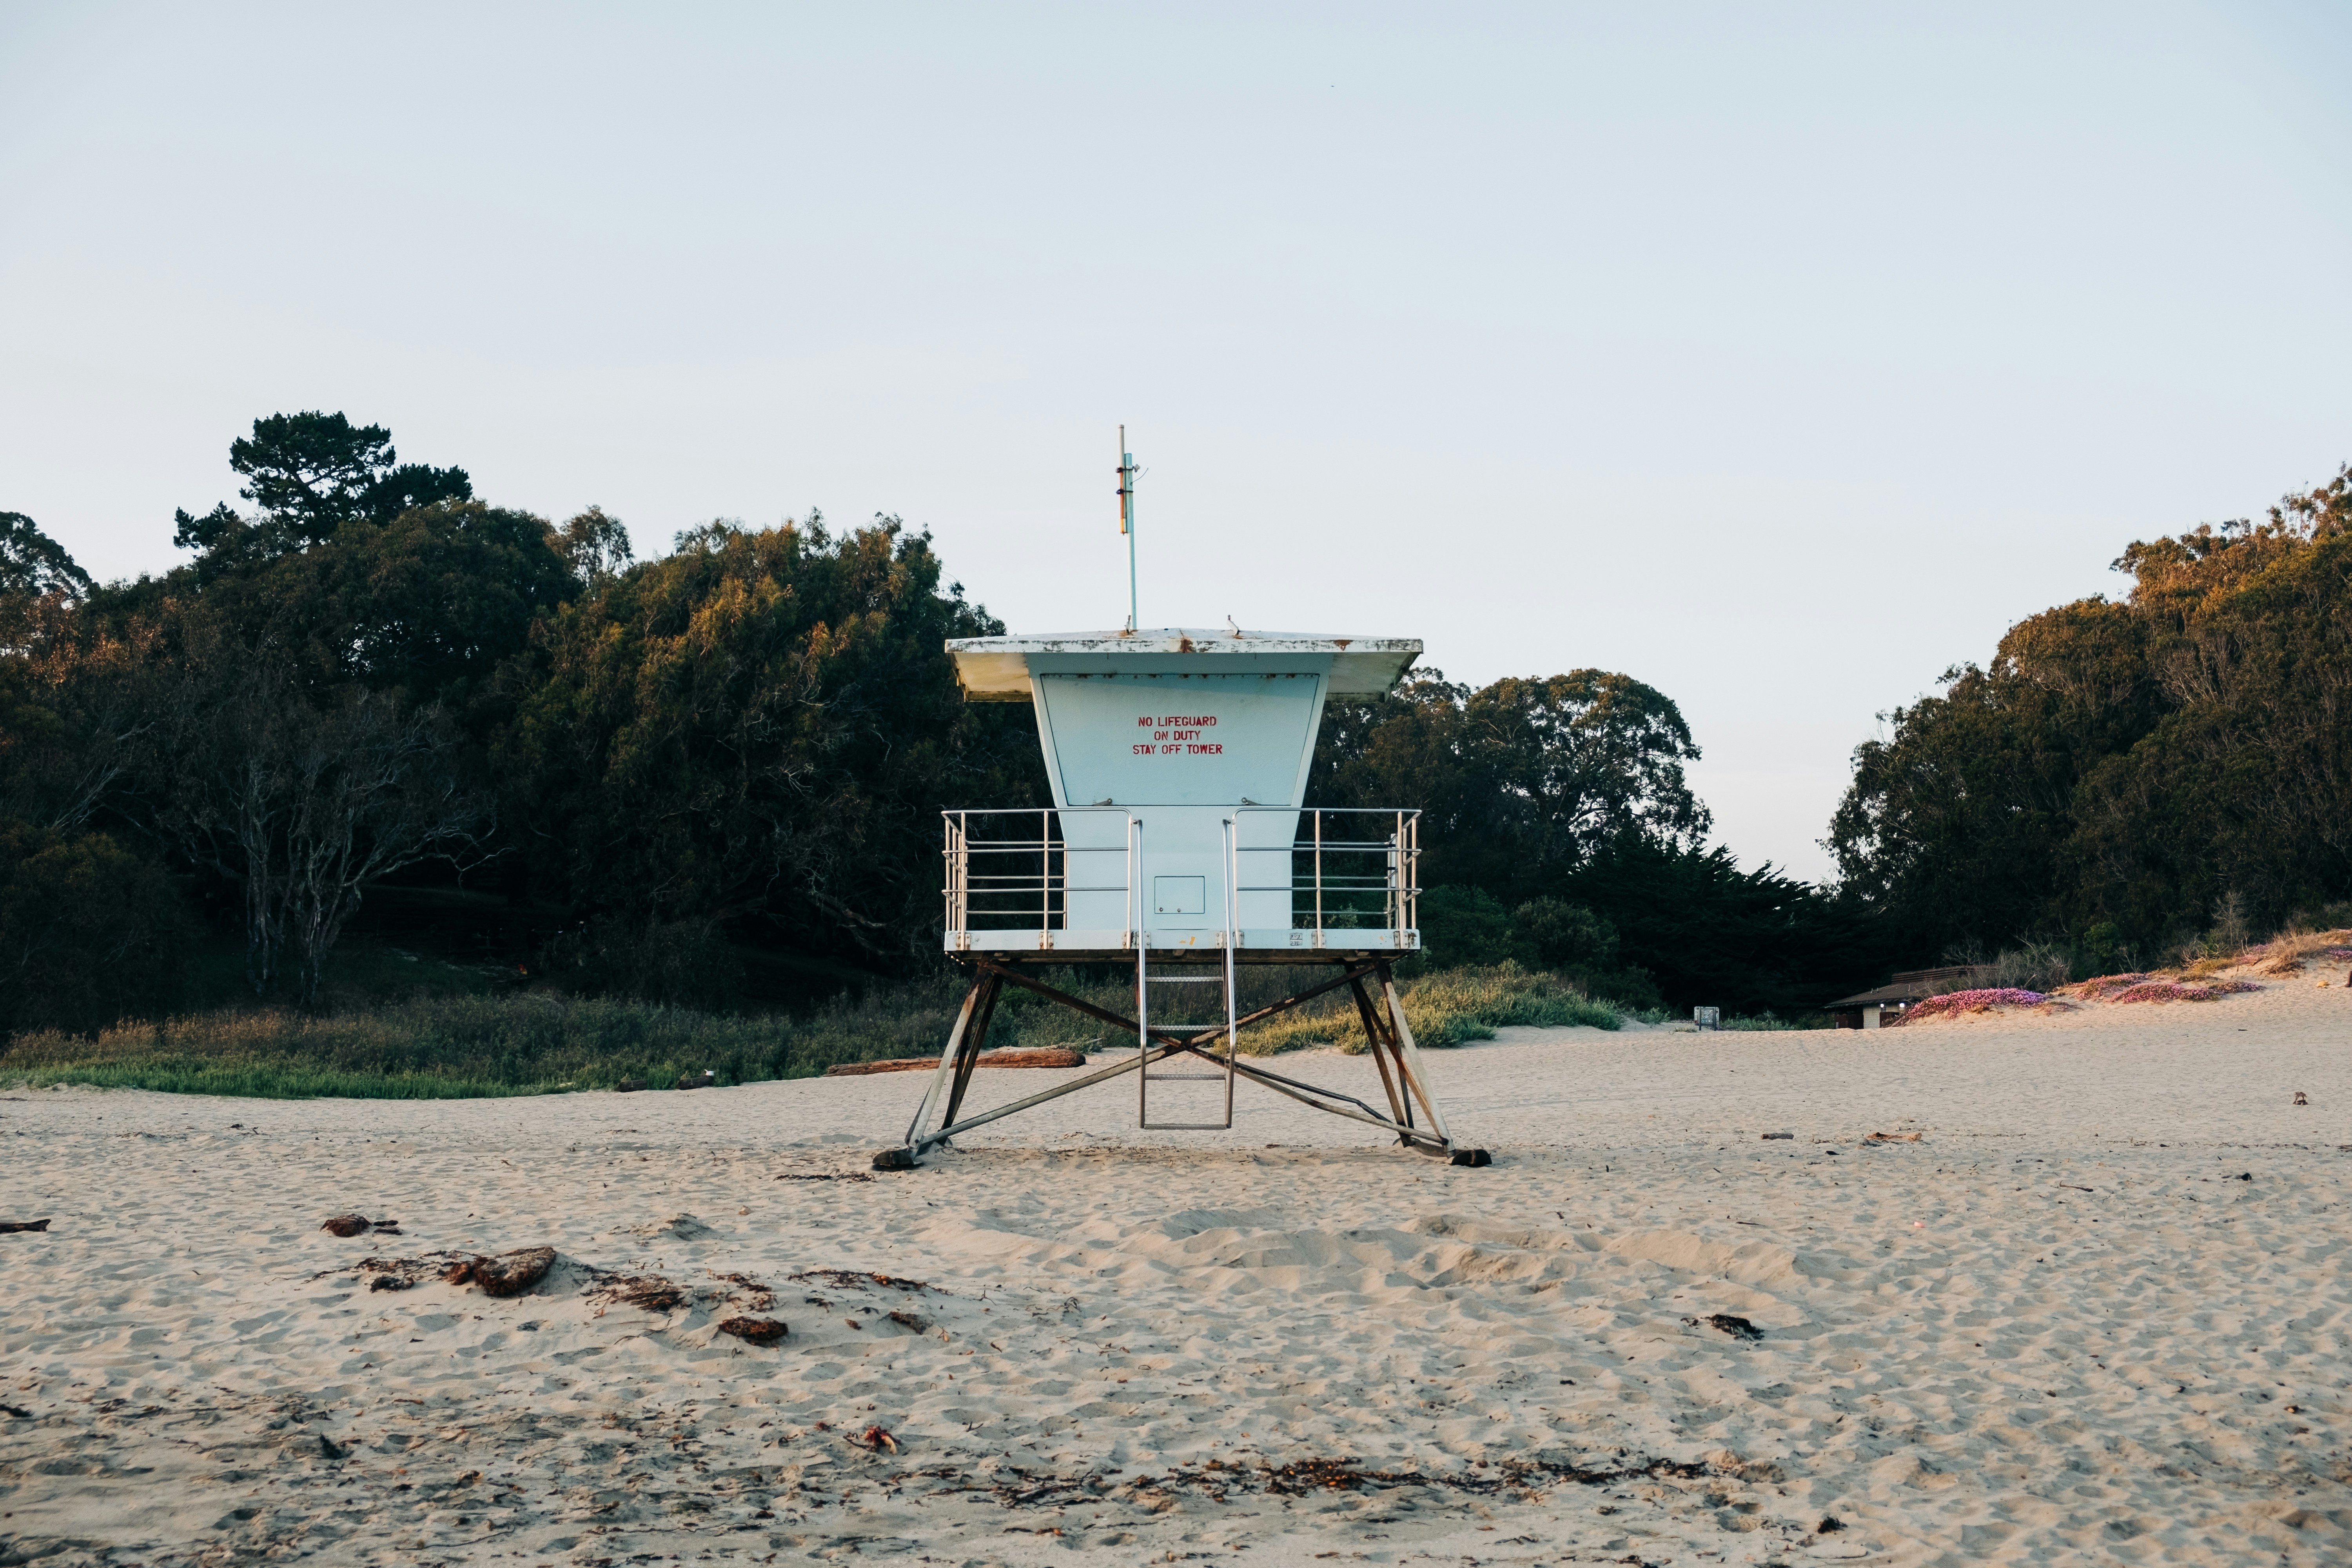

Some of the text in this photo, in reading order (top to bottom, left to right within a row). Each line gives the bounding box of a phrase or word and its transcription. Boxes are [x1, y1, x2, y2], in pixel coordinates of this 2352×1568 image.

[1138, 716, 1217, 727] NO LIFEGUARD
[1154, 730, 1201, 740] ON DUTY
[1132, 744, 1223, 755] STAY OFF TOWER
